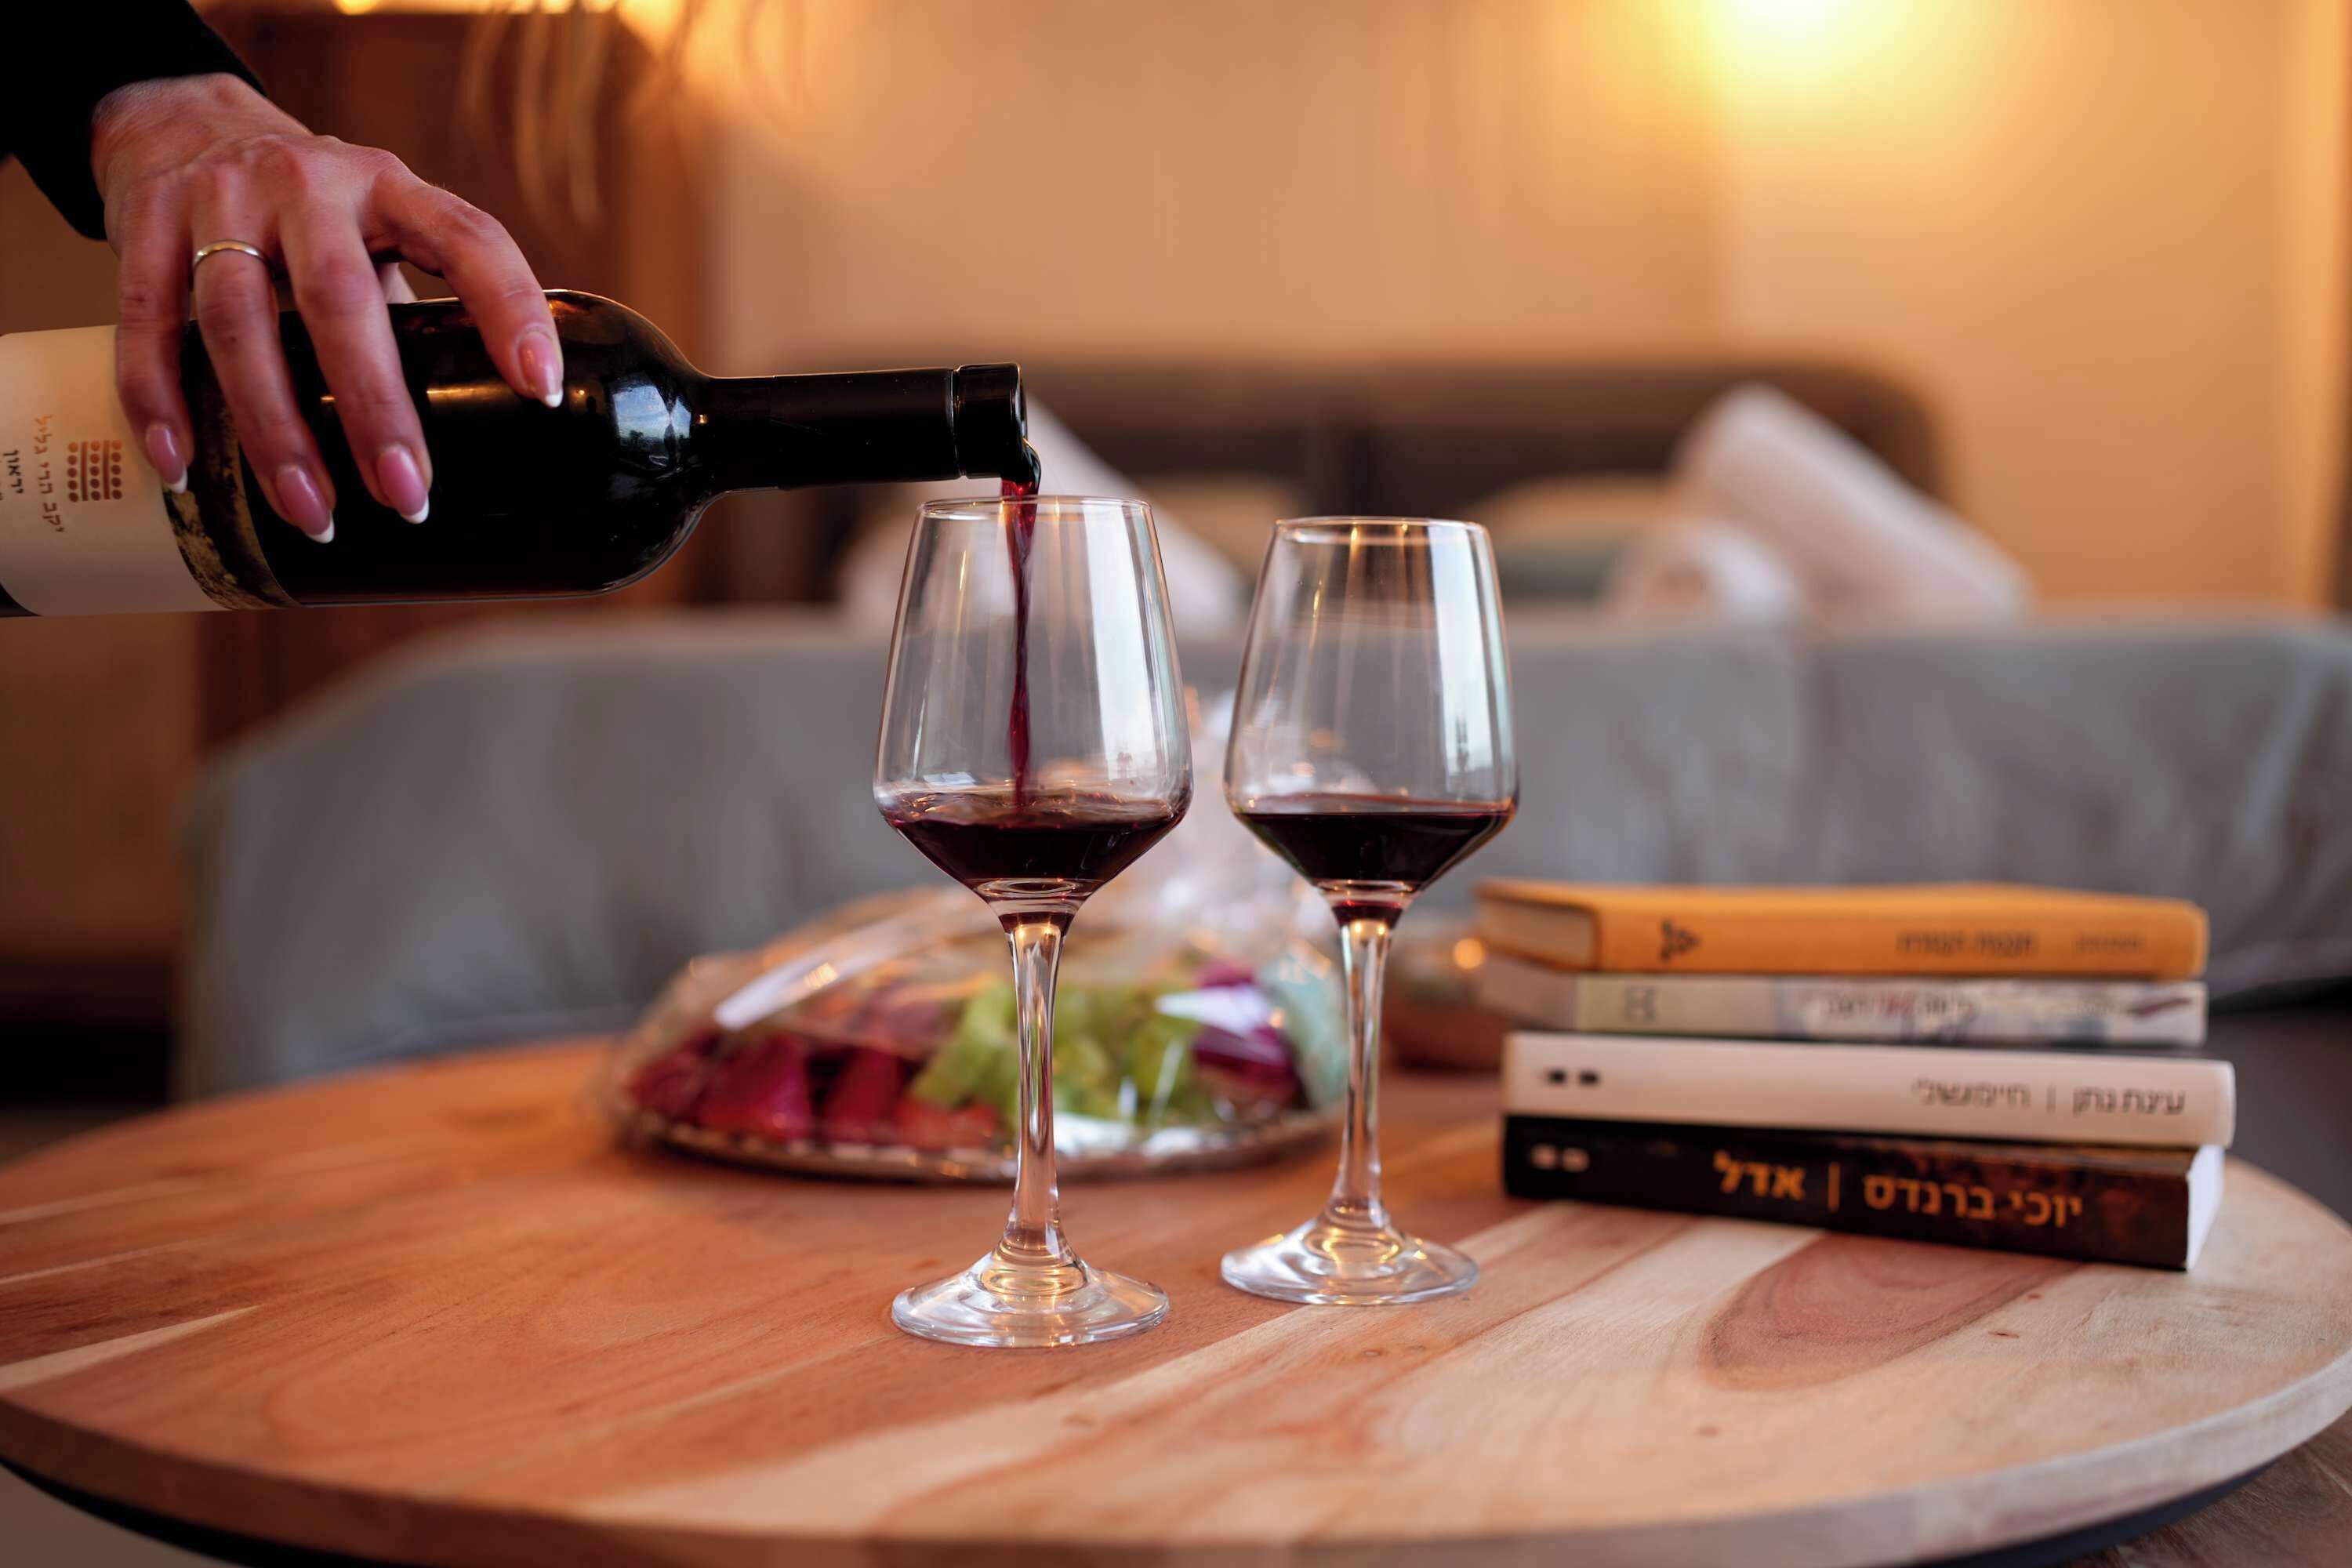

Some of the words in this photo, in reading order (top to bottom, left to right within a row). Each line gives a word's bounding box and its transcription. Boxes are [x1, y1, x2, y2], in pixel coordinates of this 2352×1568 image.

[34, 414, 54, 456] גליל
[2, 448, 24, 495] יראון
[38, 461, 53, 495] הרי
[42, 502, 66, 533] יקב
[1713, 1148, 1807, 1201] אדל
[1863, 1174, 1996, 1221] ברנדס
[2009, 1188, 2084, 1228] יוכי
